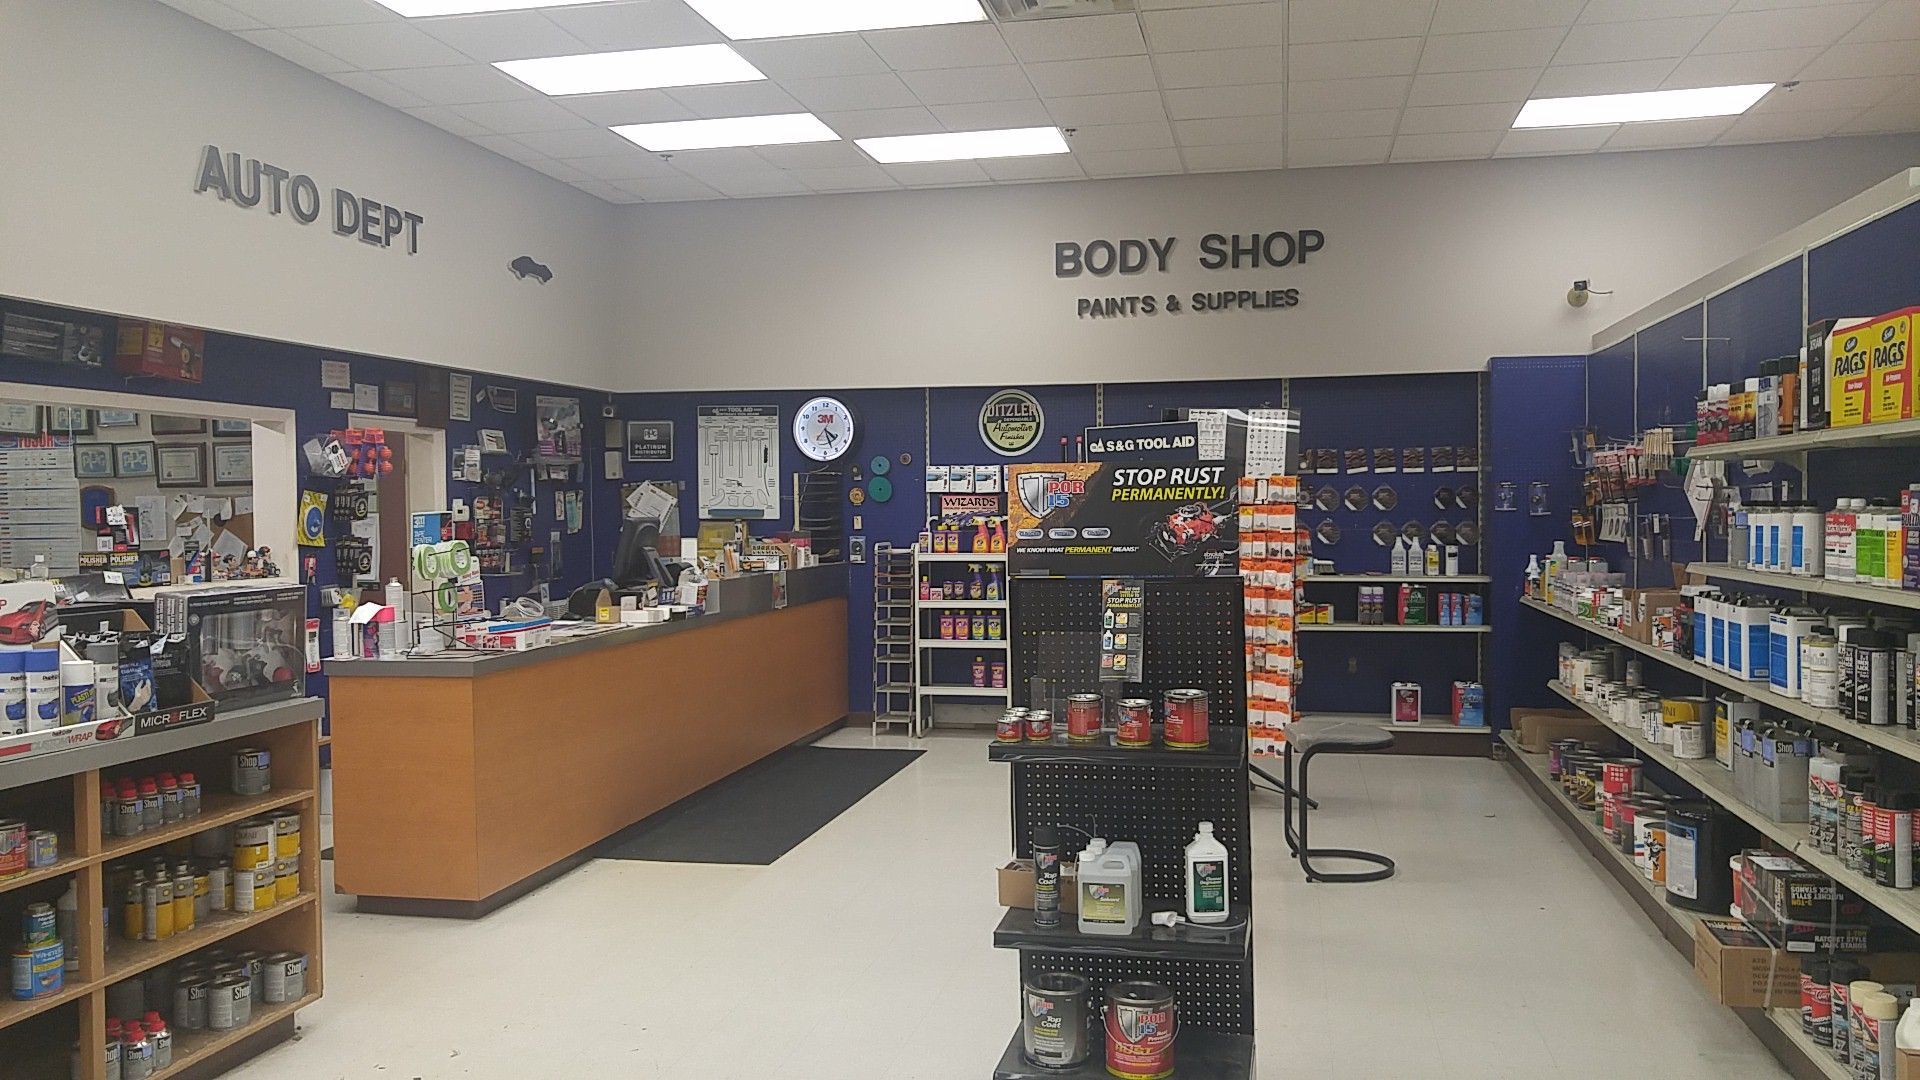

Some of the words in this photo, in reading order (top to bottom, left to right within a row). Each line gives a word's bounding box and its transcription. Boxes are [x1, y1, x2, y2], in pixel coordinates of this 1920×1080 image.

[194, 145, 320, 225] AUTO
[331, 188, 424, 256] DEPT
[1055, 237, 1176, 278] BODY
[1199, 230, 1325, 270] SHOP
[1077, 295, 1155, 319] PAINTS
[1166, 295, 1182, 312] &
[1191, 289, 1300, 312] SUPPLIES
[1873, 341, 1906, 368] RAGS
[1834, 351, 1867, 377] RAGS
[986, 403, 1037, 417] DITZLER
[817, 414, 834, 424] 3M
[993, 419, 1034, 432] Automotive
[999, 431, 1025, 441] Finishes
[1106, 440, 1135, 452] S&G
[1136, 438, 1171, 450] TOOL
[1172, 436, 1196, 448] AID
[1112, 467, 1167, 487] STOP
[1169, 466, 1226, 486] RUST
[1047, 480, 1085, 494] POR
[1111, 486, 1226, 502] PERMANENTLY!
[943, 497, 996, 507] WIZARDS
[1046, 493, 1070, 508] 15
[1064, 546, 1112, 554] PERMANENT
[79, 556, 107, 564] POLISHER
[110, 554, 139, 562] POLISHER
[67, 731, 93, 743] WRAP
[1777, 742, 1794, 753] Shop
[240, 755, 258, 768] Shop
[143, 799, 158, 809] Shop
[163, 793, 177, 803] Shop
[120, 805, 135, 814] Shop
[1046, 1015, 1062, 1023] Top
[1138, 1012, 1166, 1025] POR
[1138, 1023, 1157, 1035] 15
[128, 1049, 142, 1060] Shop
